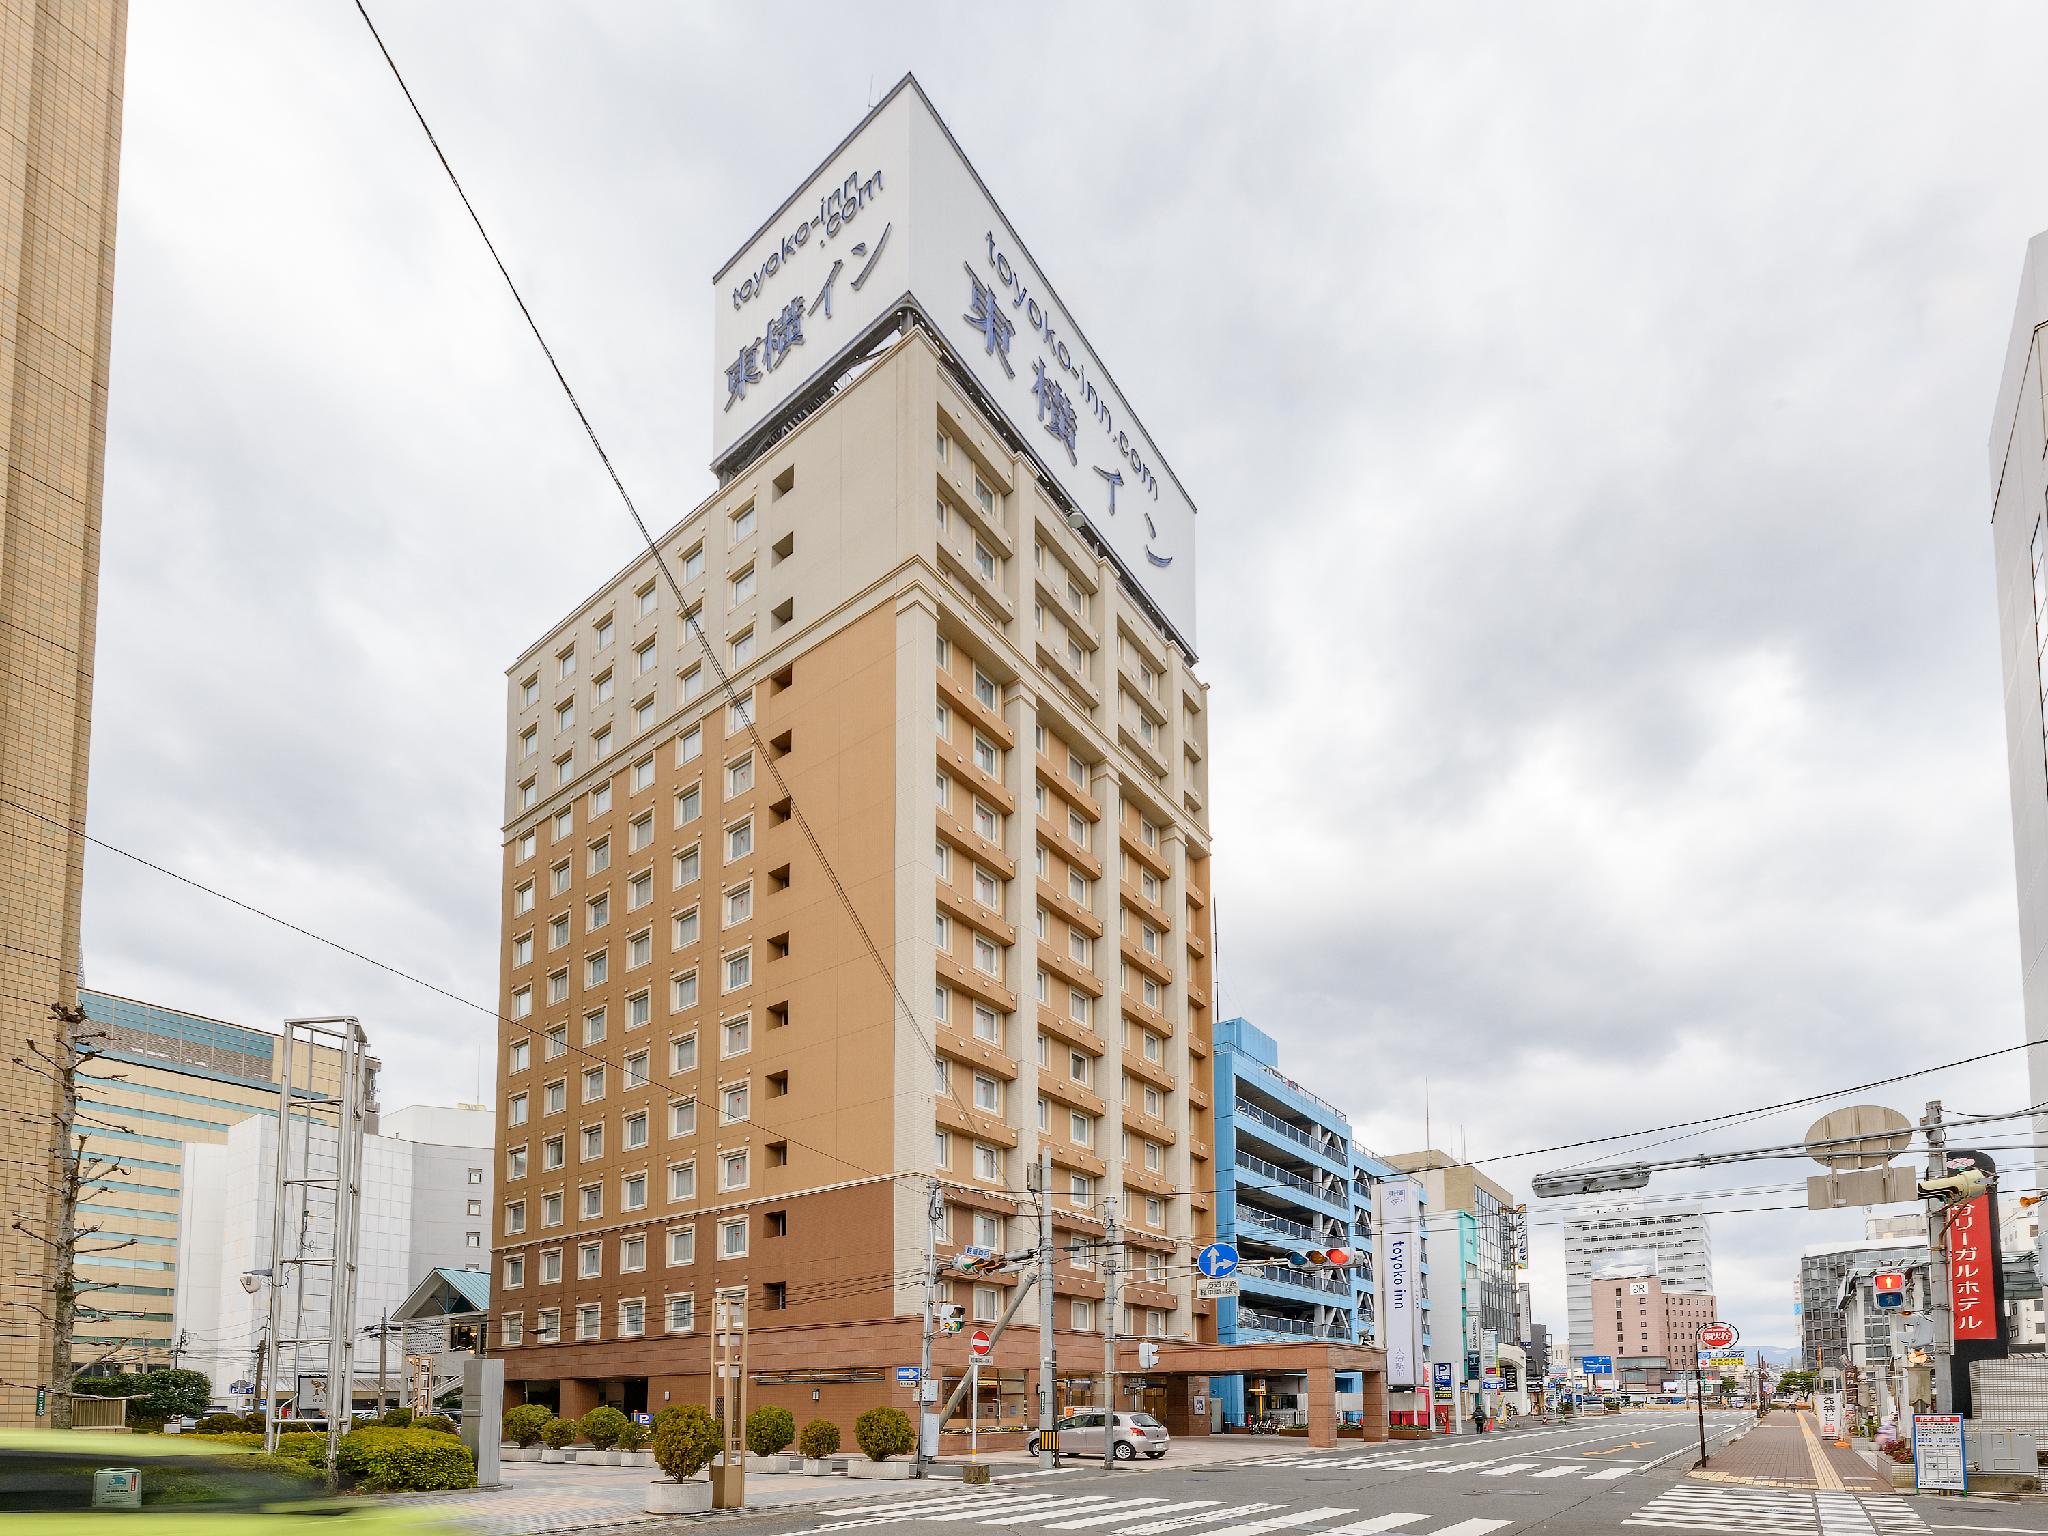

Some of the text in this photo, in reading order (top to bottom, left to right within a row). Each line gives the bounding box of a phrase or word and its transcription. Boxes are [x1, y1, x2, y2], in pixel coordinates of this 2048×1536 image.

[731, 170, 860, 311] toyoko-inn
[819, 169, 884, 249] .com
[723, 222, 893, 413] 東横イン
[985, 230, 1159, 501] toyoko-inn.com
[962, 260, 1174, 568] 東横イン
[1390, 1240, 1408, 1310] toyoko inn
[639, 1414, 650, 1424] P
[1439, 1364, 1448, 1375] P
